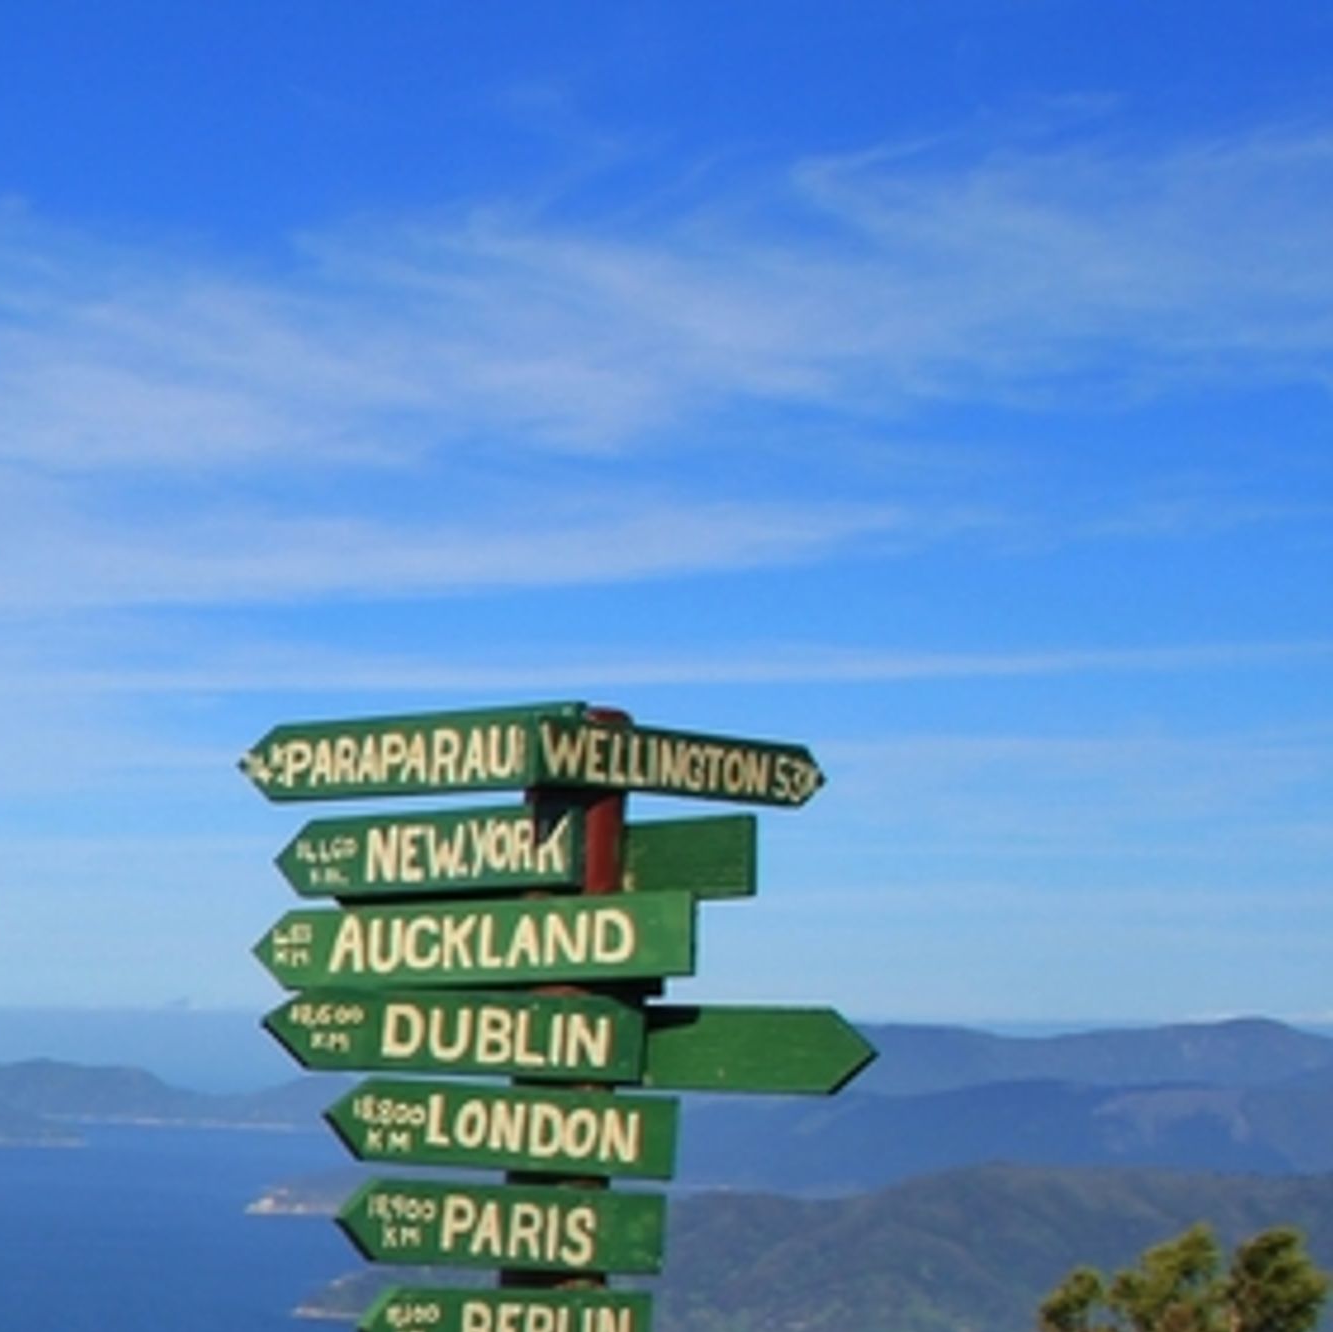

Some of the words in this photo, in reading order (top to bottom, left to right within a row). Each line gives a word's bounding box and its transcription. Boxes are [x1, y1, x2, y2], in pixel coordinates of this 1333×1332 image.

[540, 719, 767, 796] WELLINGTON
[329, 908, 635, 974] AUCKLAND
[380, 1002, 611, 1069] DUBLIN
[424, 1093, 640, 1163] LONDON
[439, 1193, 597, 1266] PARIS
